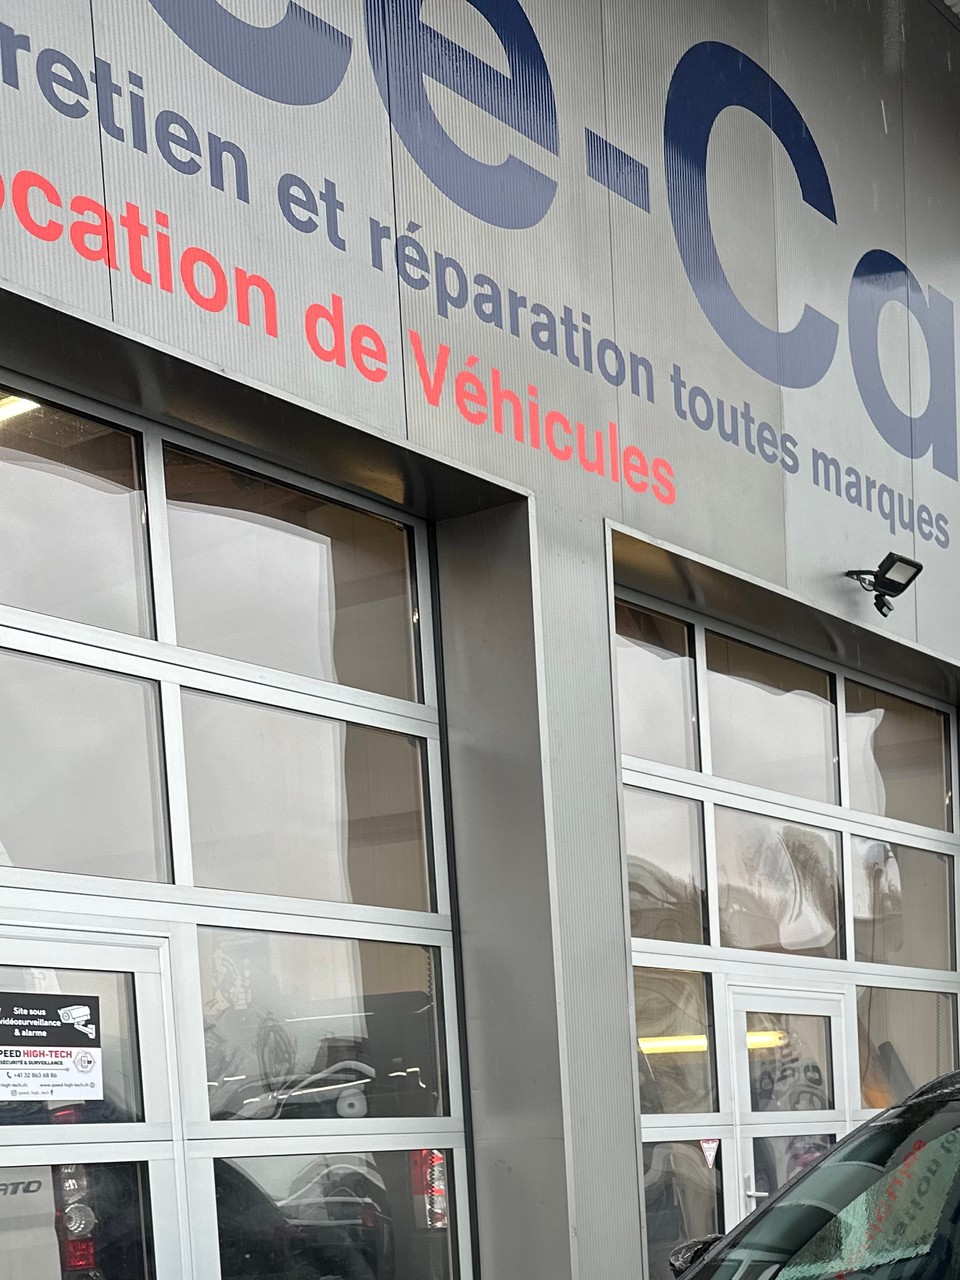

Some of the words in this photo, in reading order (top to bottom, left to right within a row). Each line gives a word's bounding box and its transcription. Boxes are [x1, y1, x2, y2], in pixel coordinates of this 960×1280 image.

[0, 22, 250, 204] retien
[278, 173, 347, 252] et
[370, 217, 655, 404] réparation
[670, 365, 799, 475] toutes
[812, 447, 950, 549] marques
[0, 170, 278, 338] cation
[305, 295, 388, 383] de
[408, 329, 677, 506] Véhicules
[13, 1007, 28, 1015] Site
[14, 1028, 21, 1036] &
[21, 1029, 47, 1037] alarme
[23, 1050, 72, 1058] HIGH-TECH
